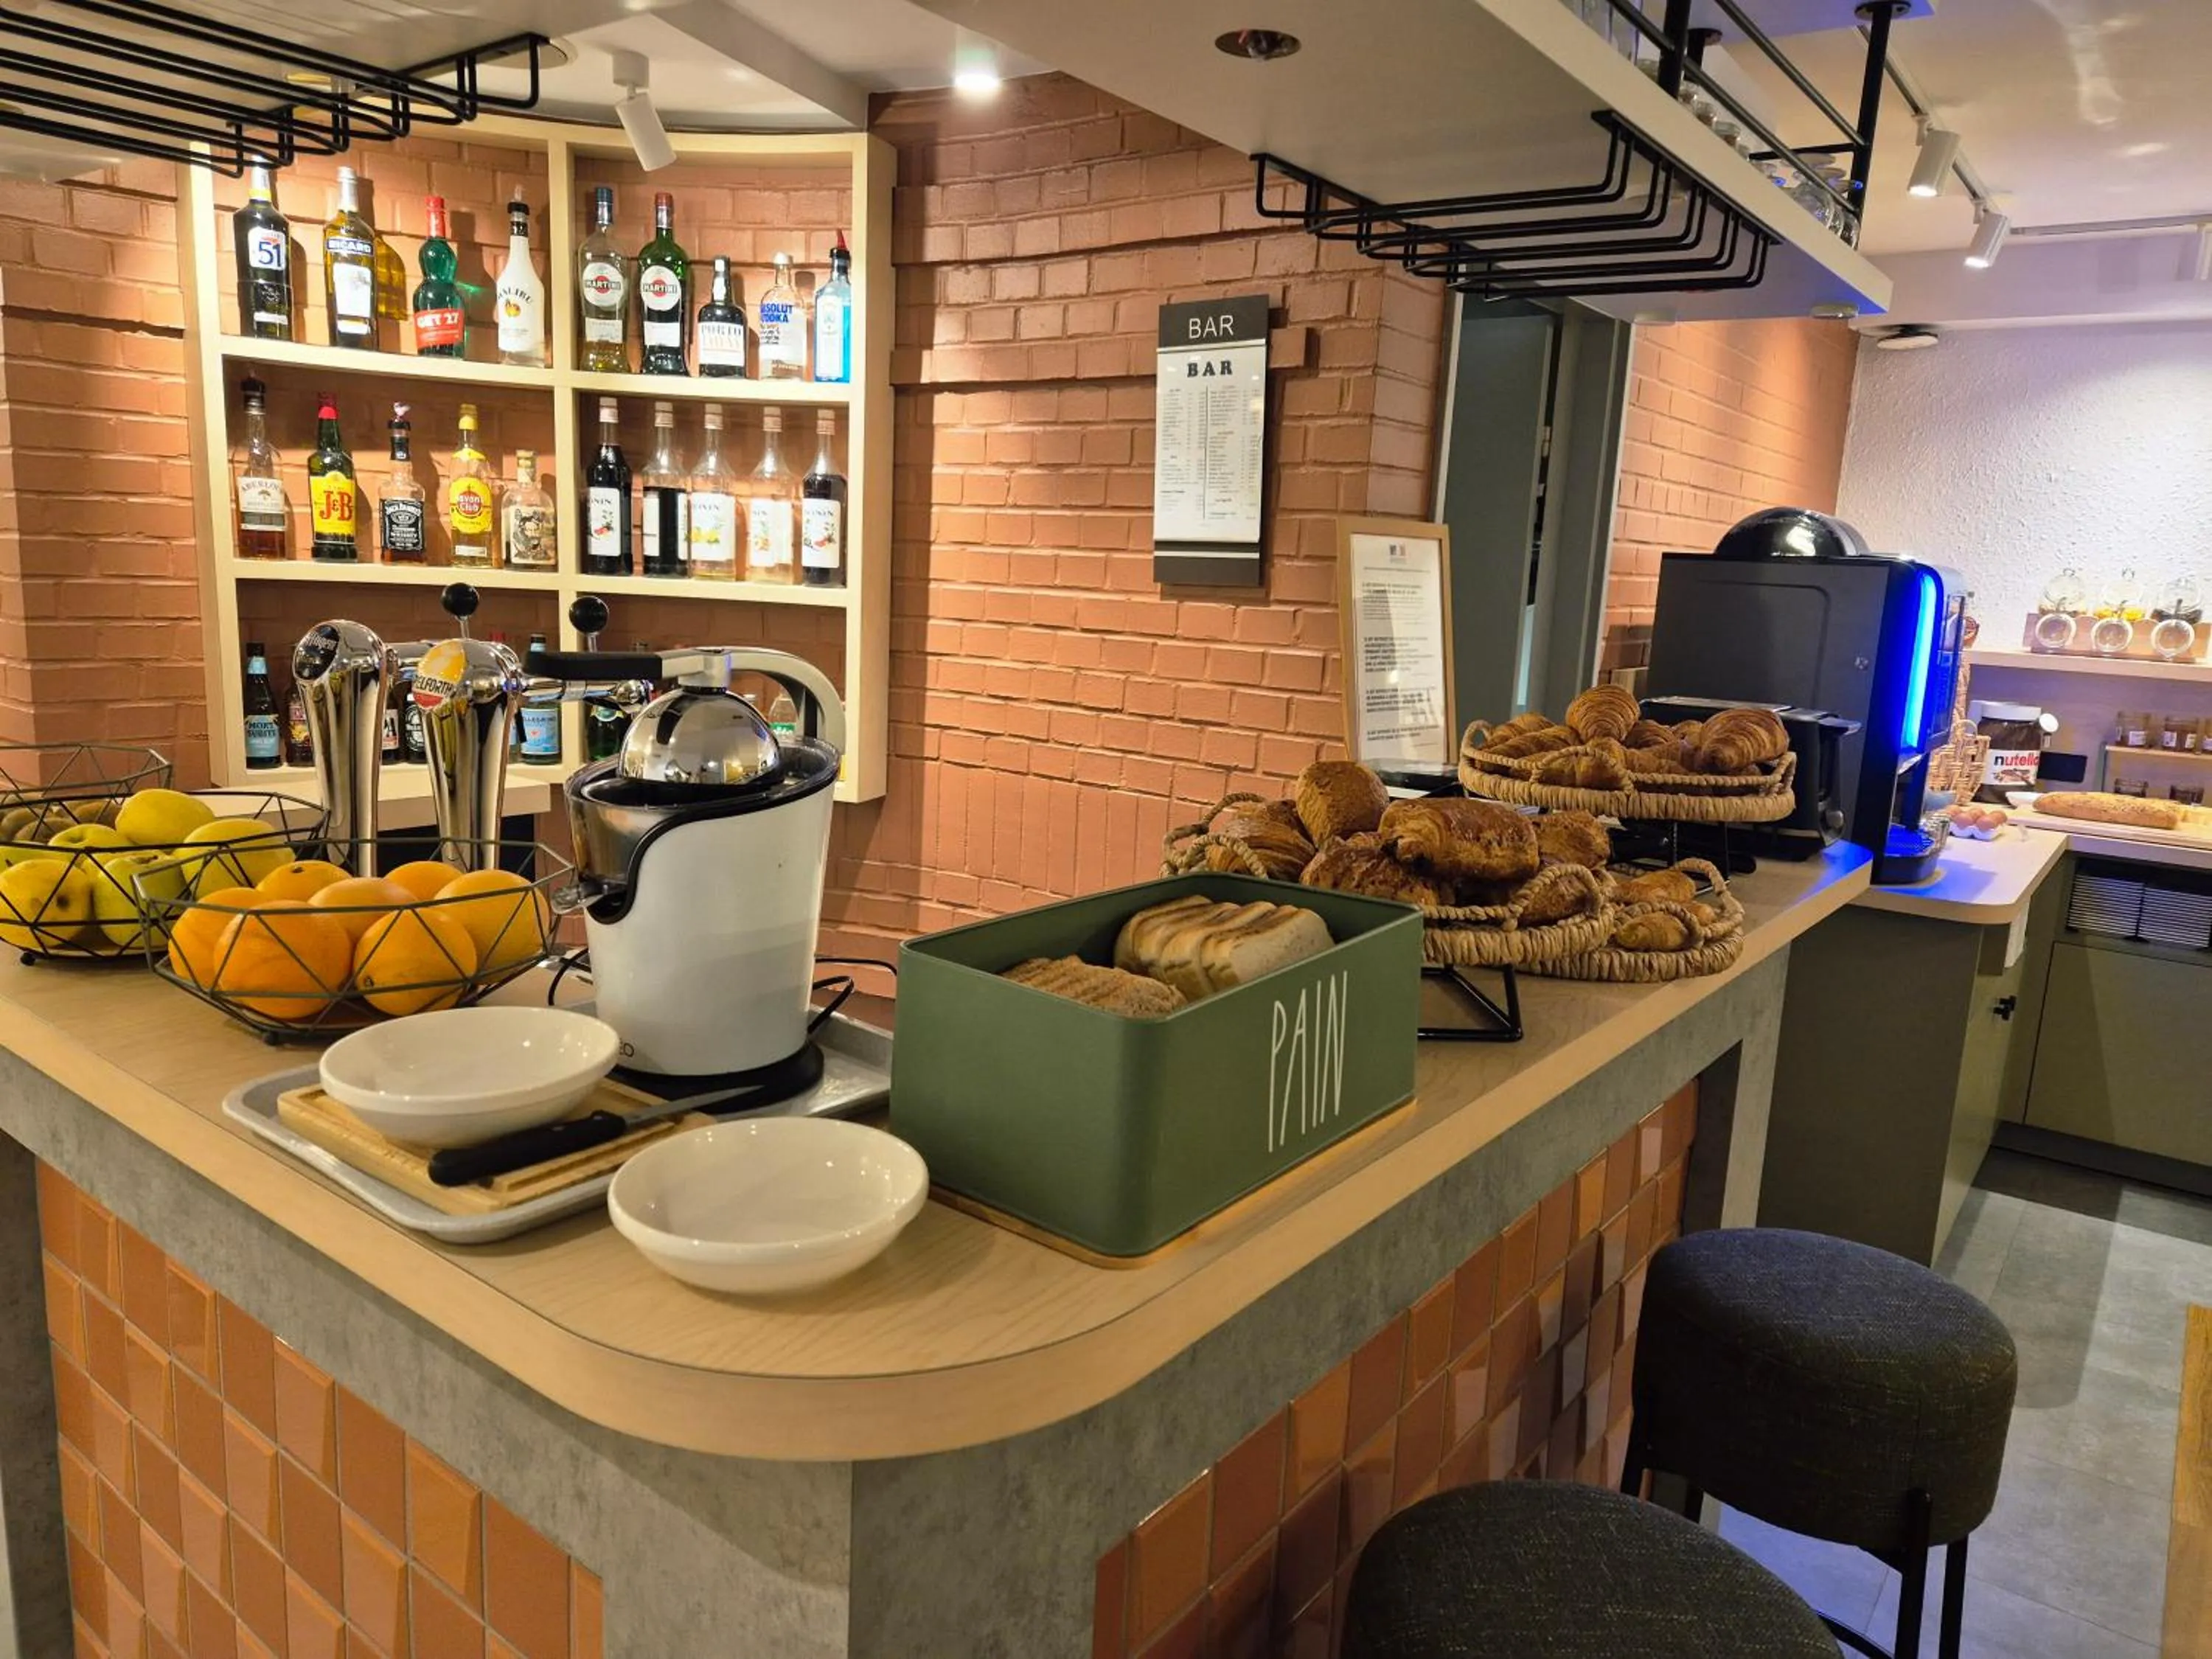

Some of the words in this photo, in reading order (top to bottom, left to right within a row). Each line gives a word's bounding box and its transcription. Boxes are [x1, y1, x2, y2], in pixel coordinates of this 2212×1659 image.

[258, 241, 282, 267] 51
[328, 240, 372, 253] RICARD
[585, 279, 621, 290] MARTINI
[642, 282, 678, 294] MARTINI
[417, 313, 442, 328] GET
[443, 312, 459, 324] 27
[1189, 315, 1234, 339] BAR
[1186, 359, 1233, 378] BAR
[1268, 970, 1348, 1153] PAIN
